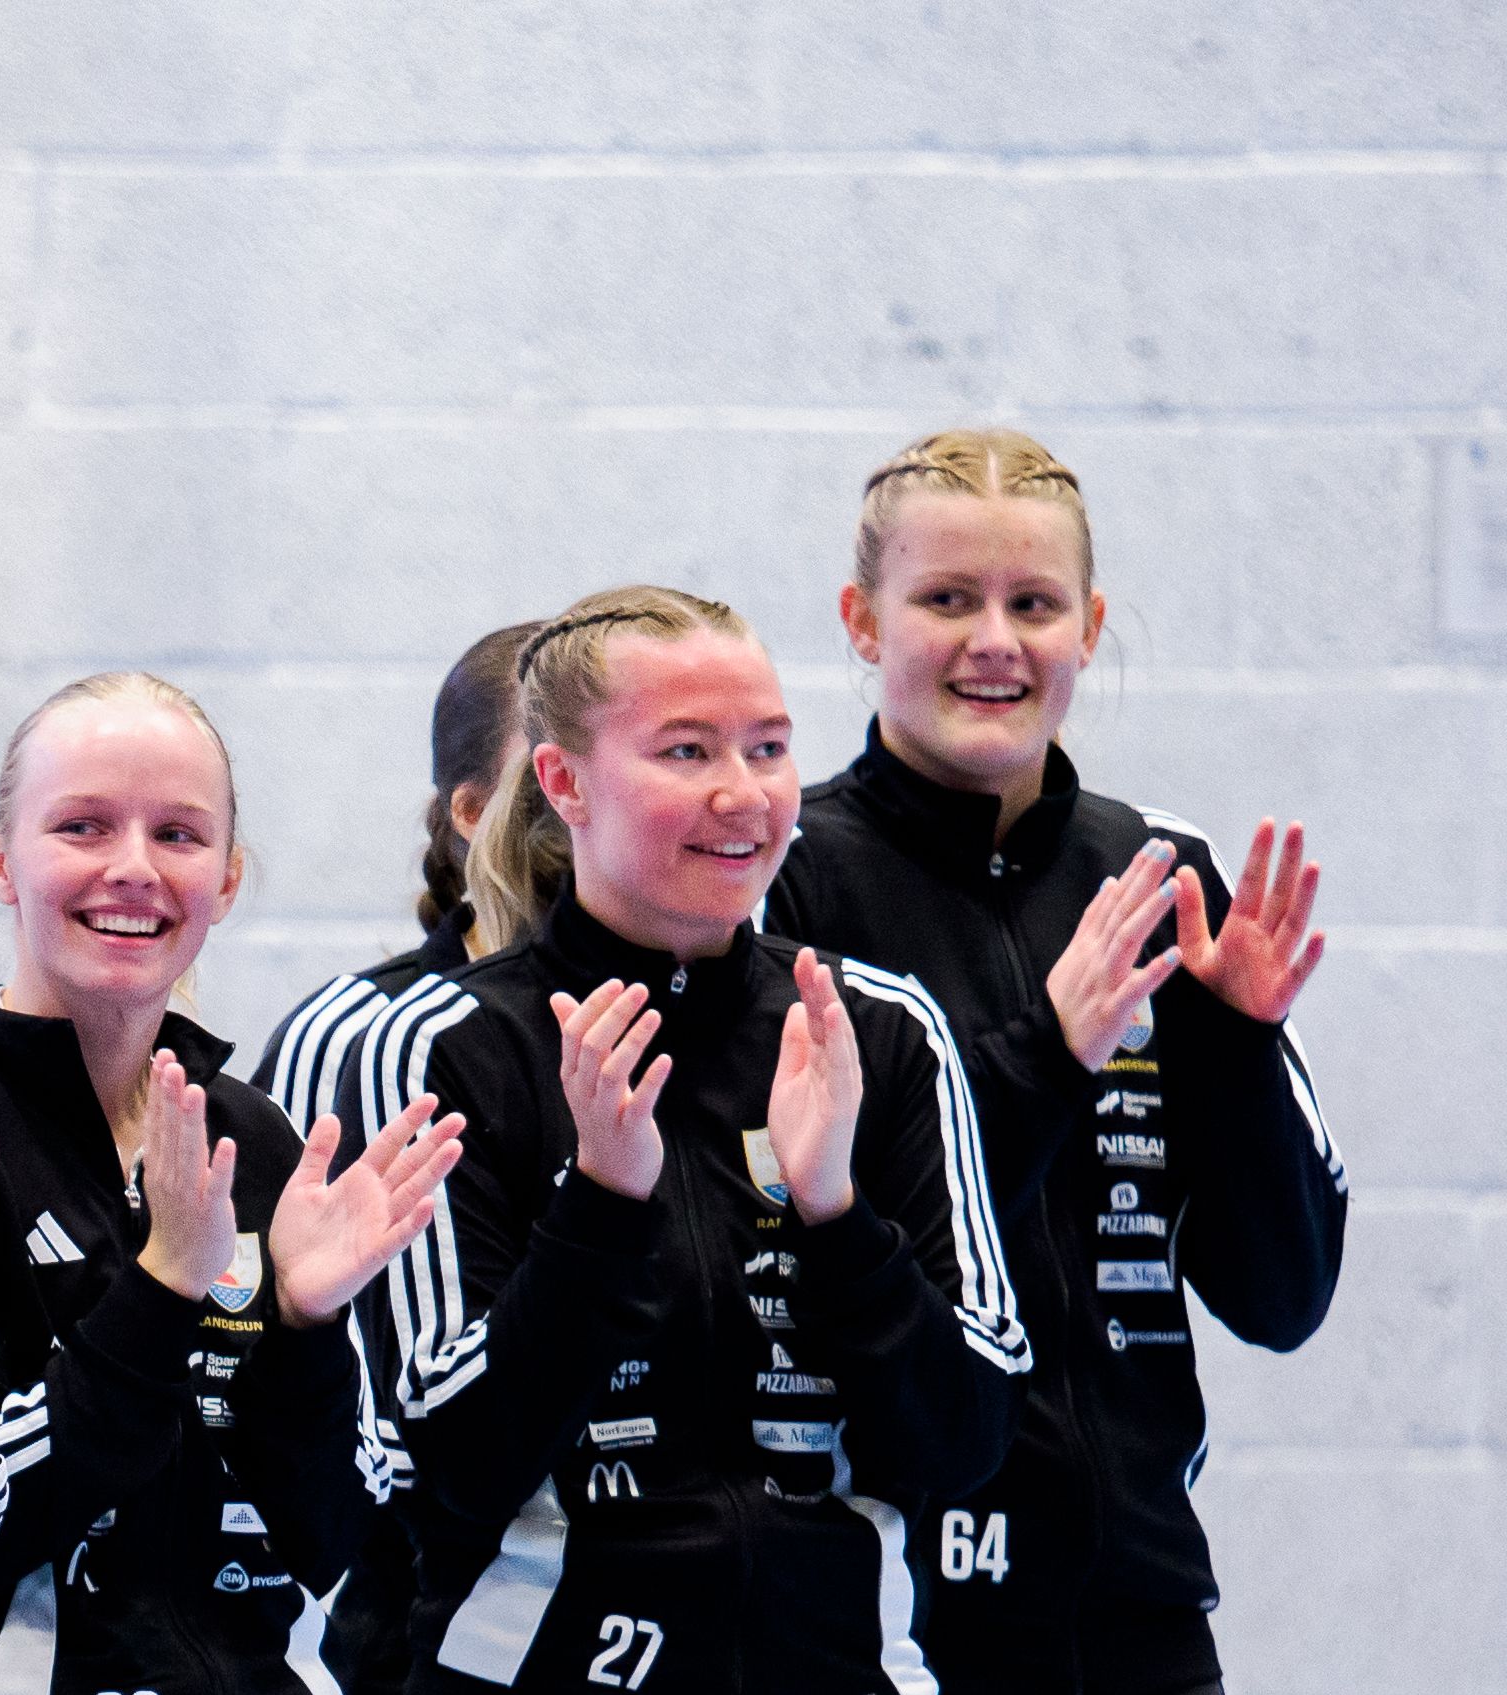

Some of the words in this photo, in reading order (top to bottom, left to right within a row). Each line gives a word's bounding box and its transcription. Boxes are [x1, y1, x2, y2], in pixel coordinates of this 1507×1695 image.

[199, 1316, 264, 1332] ANDESUN
[940, 1509, 1009, 1583] 64
[222, 1572, 243, 1585] BM
[588, 1614, 664, 1691] 27
